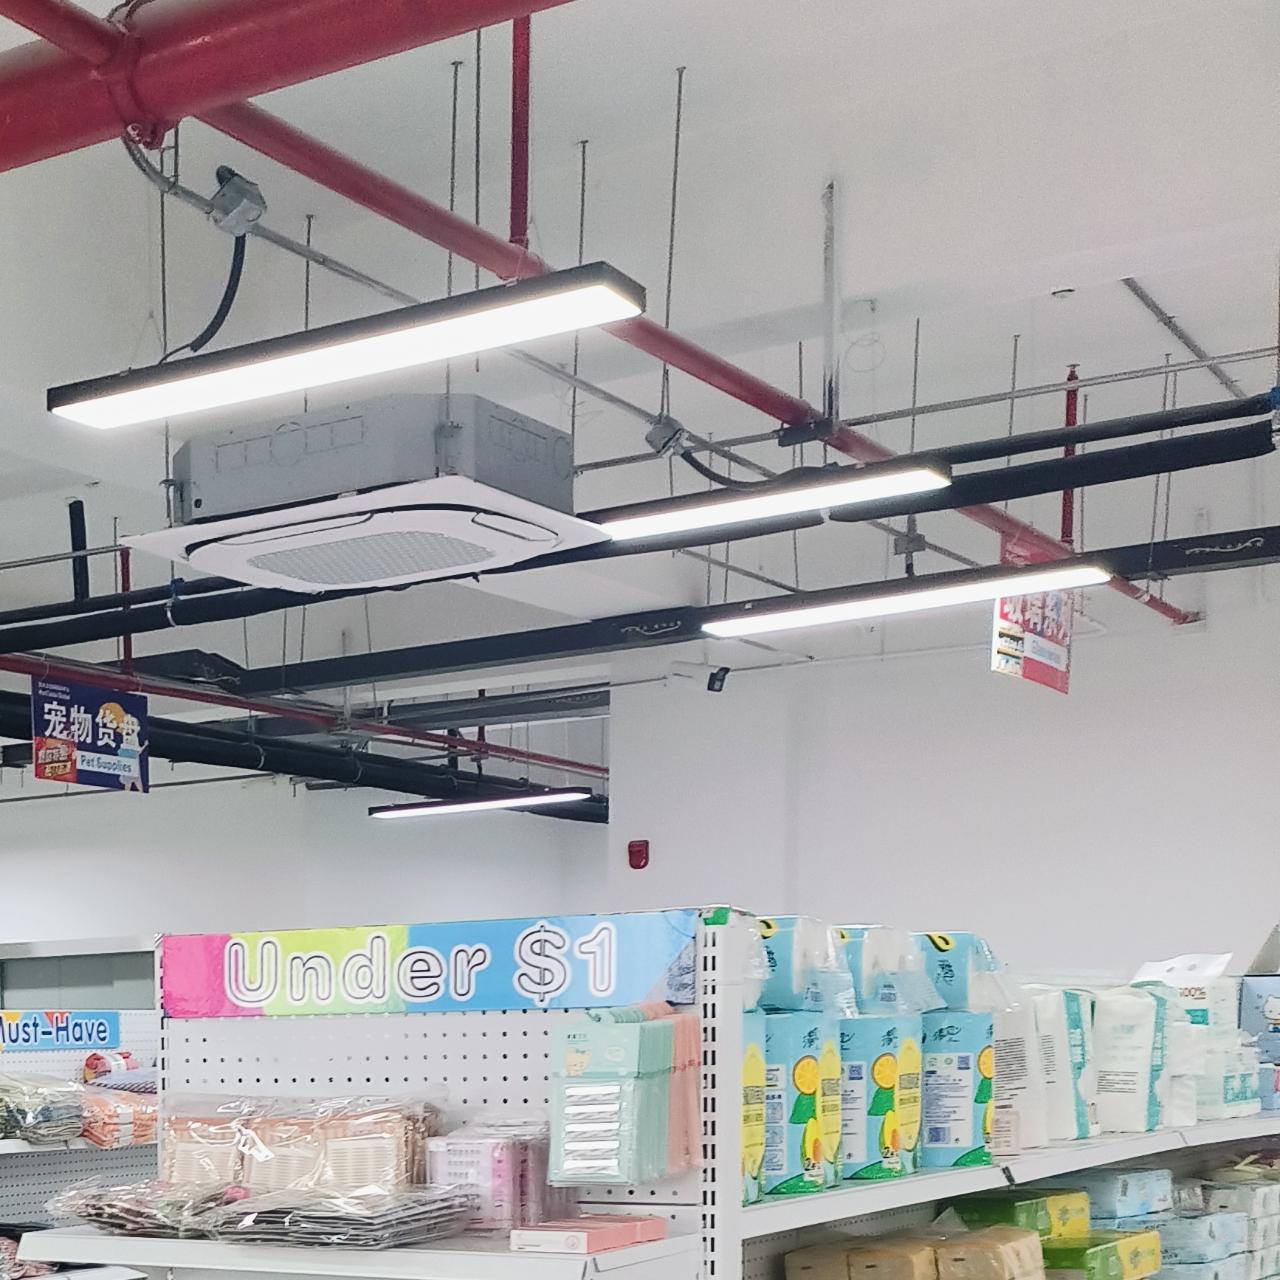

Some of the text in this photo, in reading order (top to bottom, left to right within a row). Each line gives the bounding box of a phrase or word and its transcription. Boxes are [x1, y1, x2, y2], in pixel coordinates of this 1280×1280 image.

[80, 754, 95, 767] Pet
[226, 922, 617, 1004] Under $1
